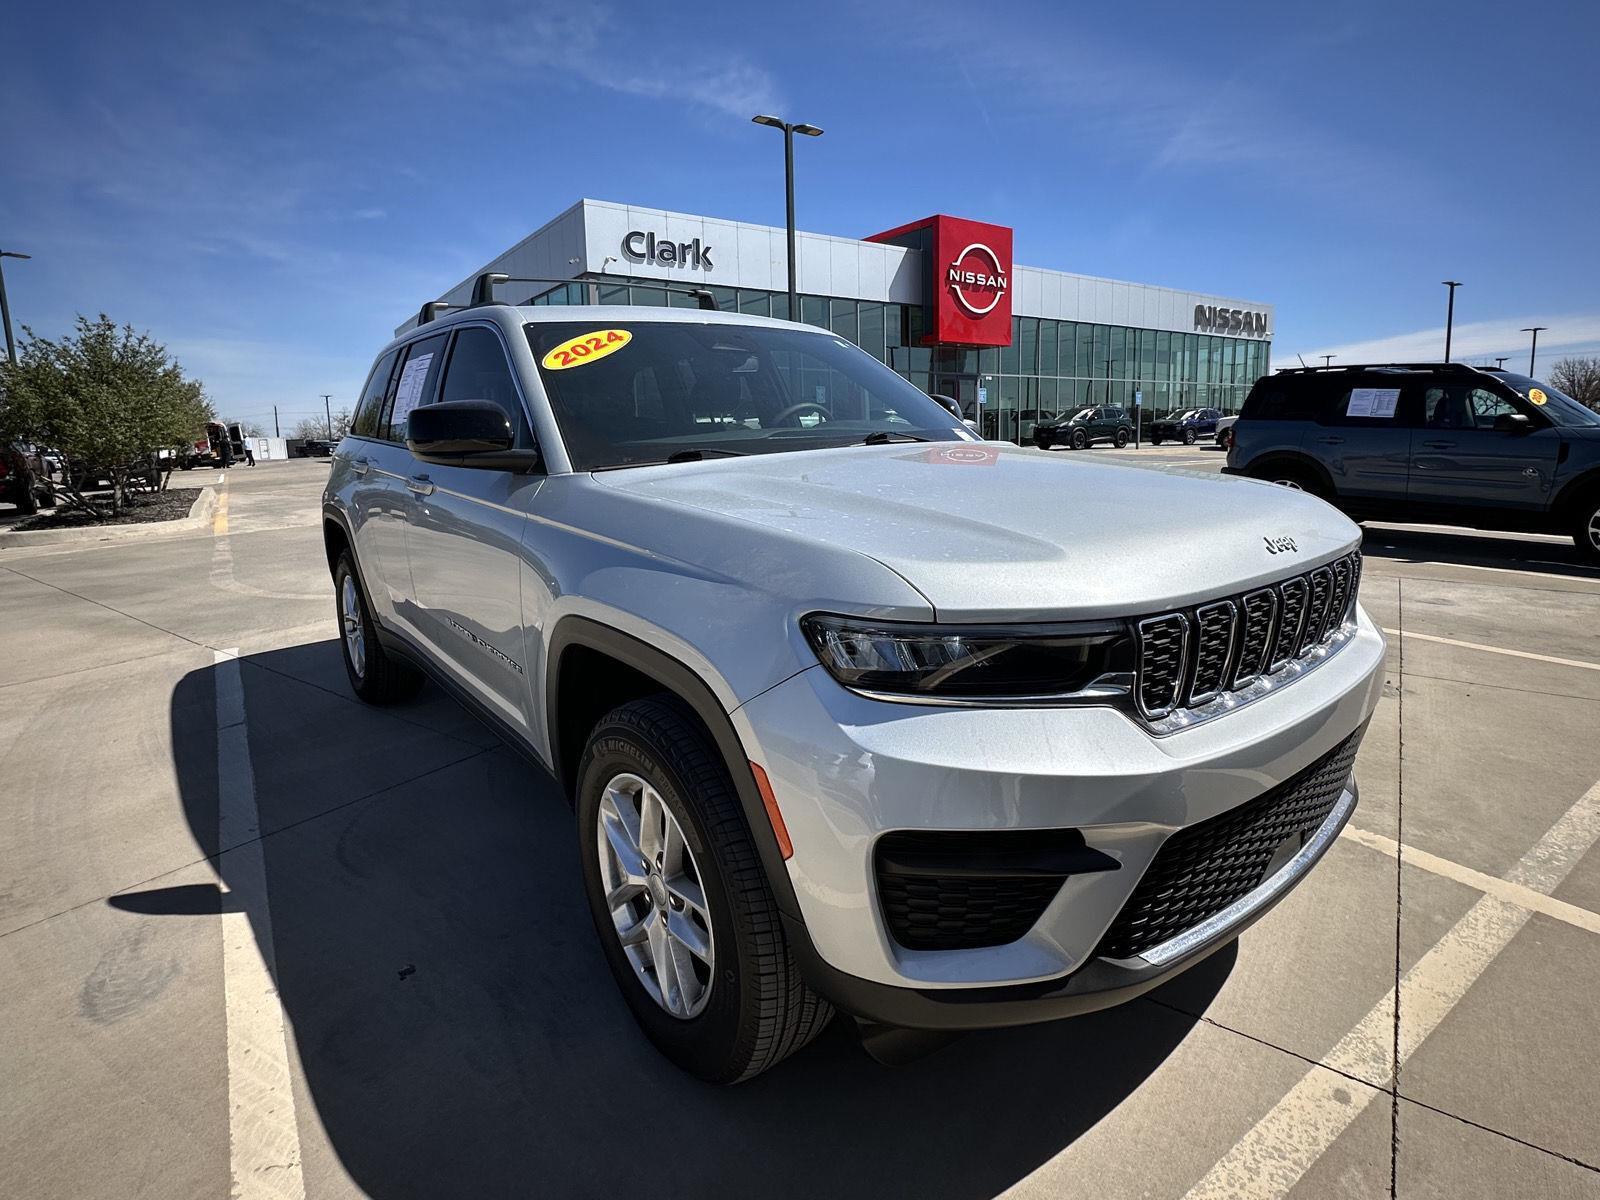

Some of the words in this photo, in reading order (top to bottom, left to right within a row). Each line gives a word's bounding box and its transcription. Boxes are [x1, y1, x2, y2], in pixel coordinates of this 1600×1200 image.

[621, 231, 714, 271] Clark
[949, 268, 1007, 289] NISSAN
[1194, 305, 1267, 336] NISSAN
[553, 331, 624, 366] 2024
[1263, 536, 1298, 555] Jeep
